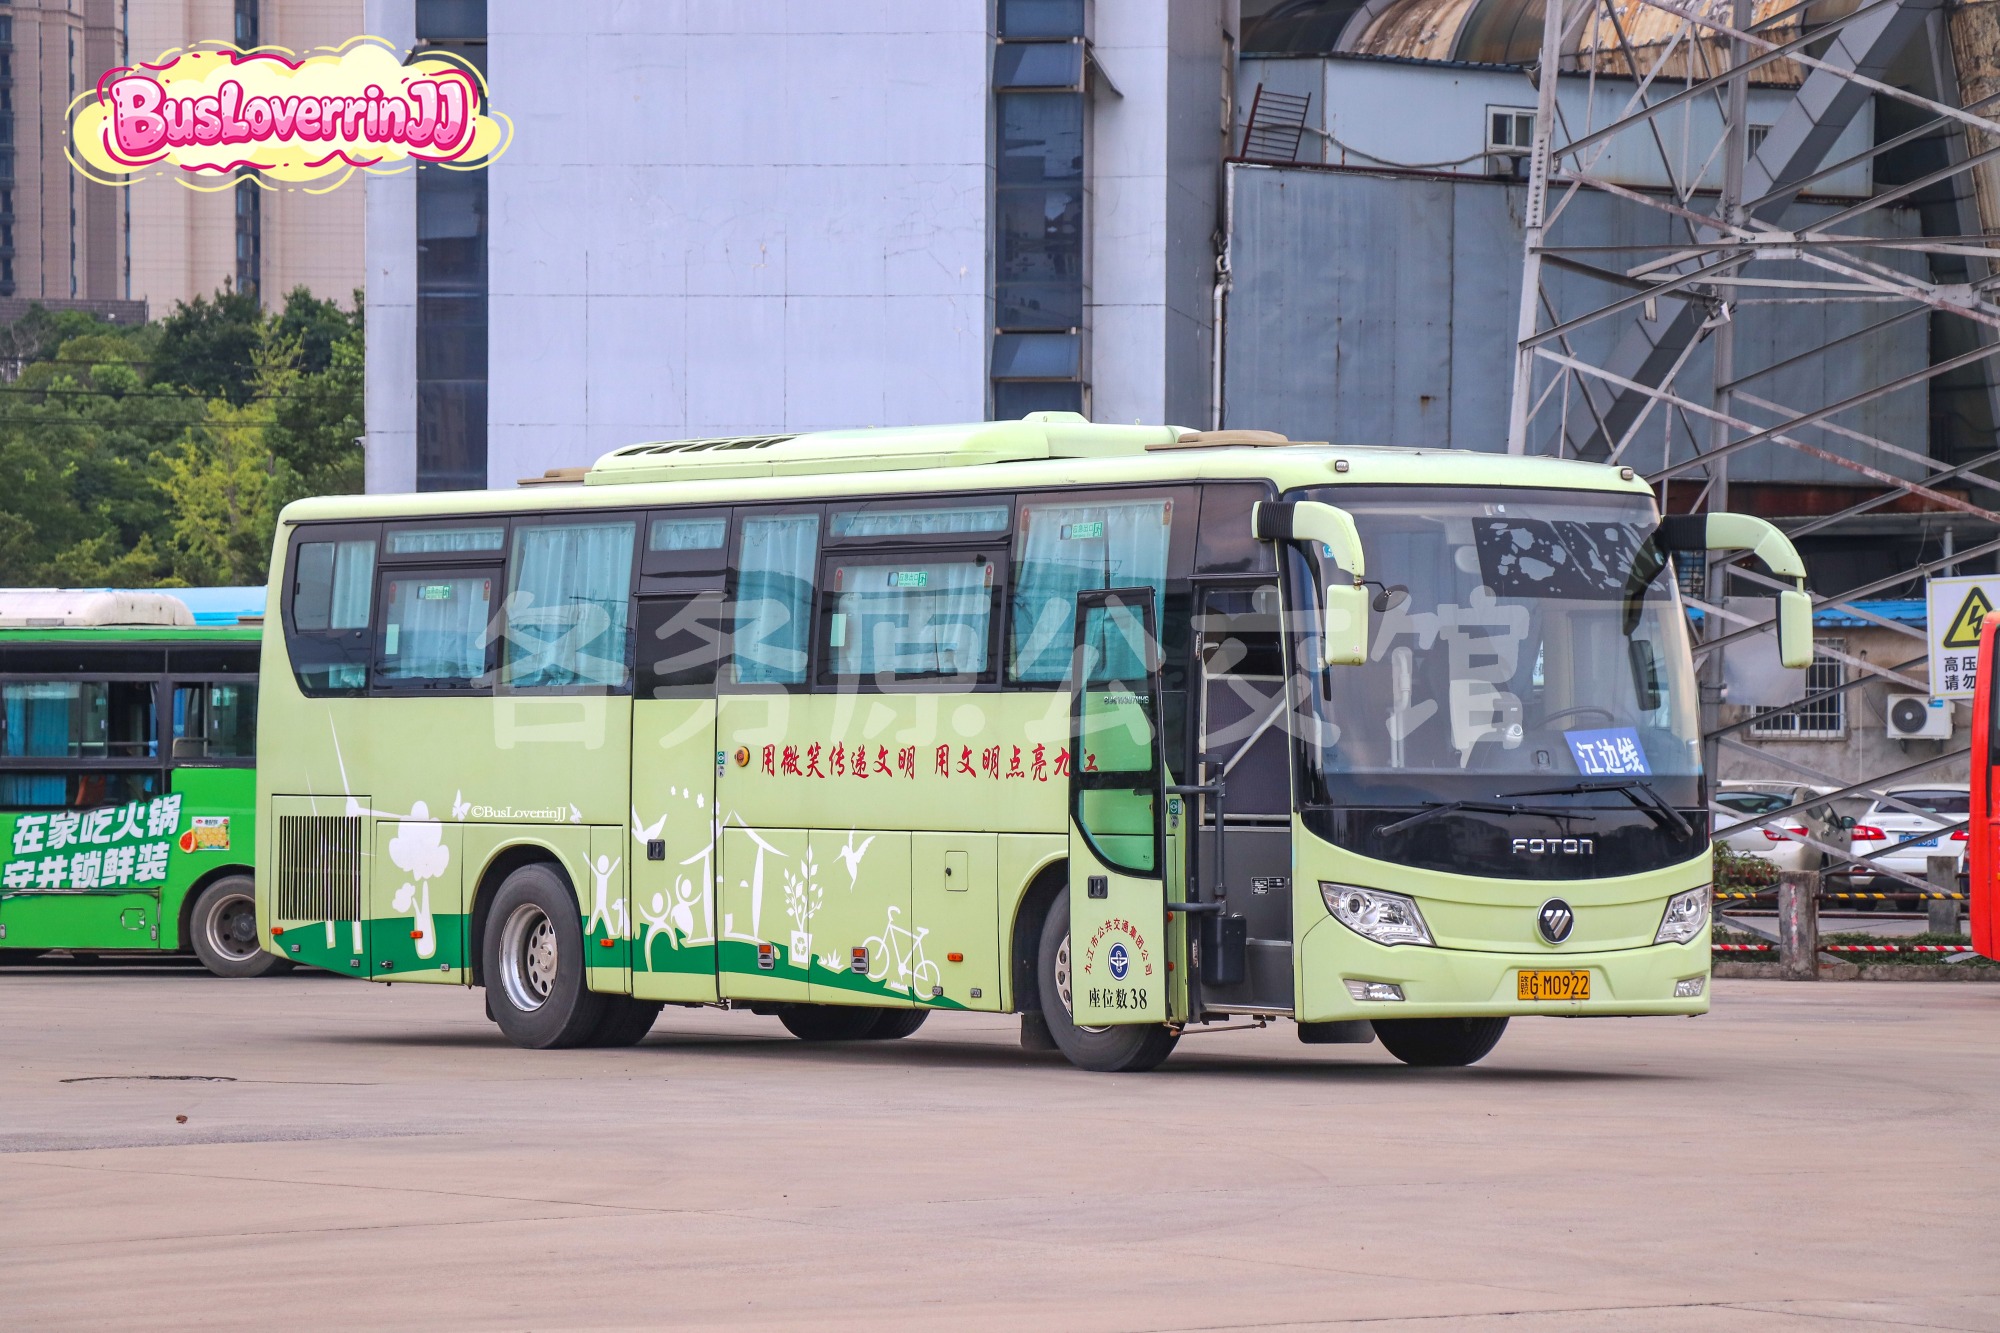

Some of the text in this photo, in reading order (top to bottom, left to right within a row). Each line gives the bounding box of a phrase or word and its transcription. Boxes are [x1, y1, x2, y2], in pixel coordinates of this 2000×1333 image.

[761, 742, 916, 779] 用微笑传递文明
[1576, 737, 1645, 775] 江边线
[13, 794, 182, 855] 在家吃火锅
[1512, 838, 1593, 854] FOTON
[3, 842, 170, 890] 安井锁鲜装
[1084, 918, 1153, 977] 九江市公共交通集团公司
